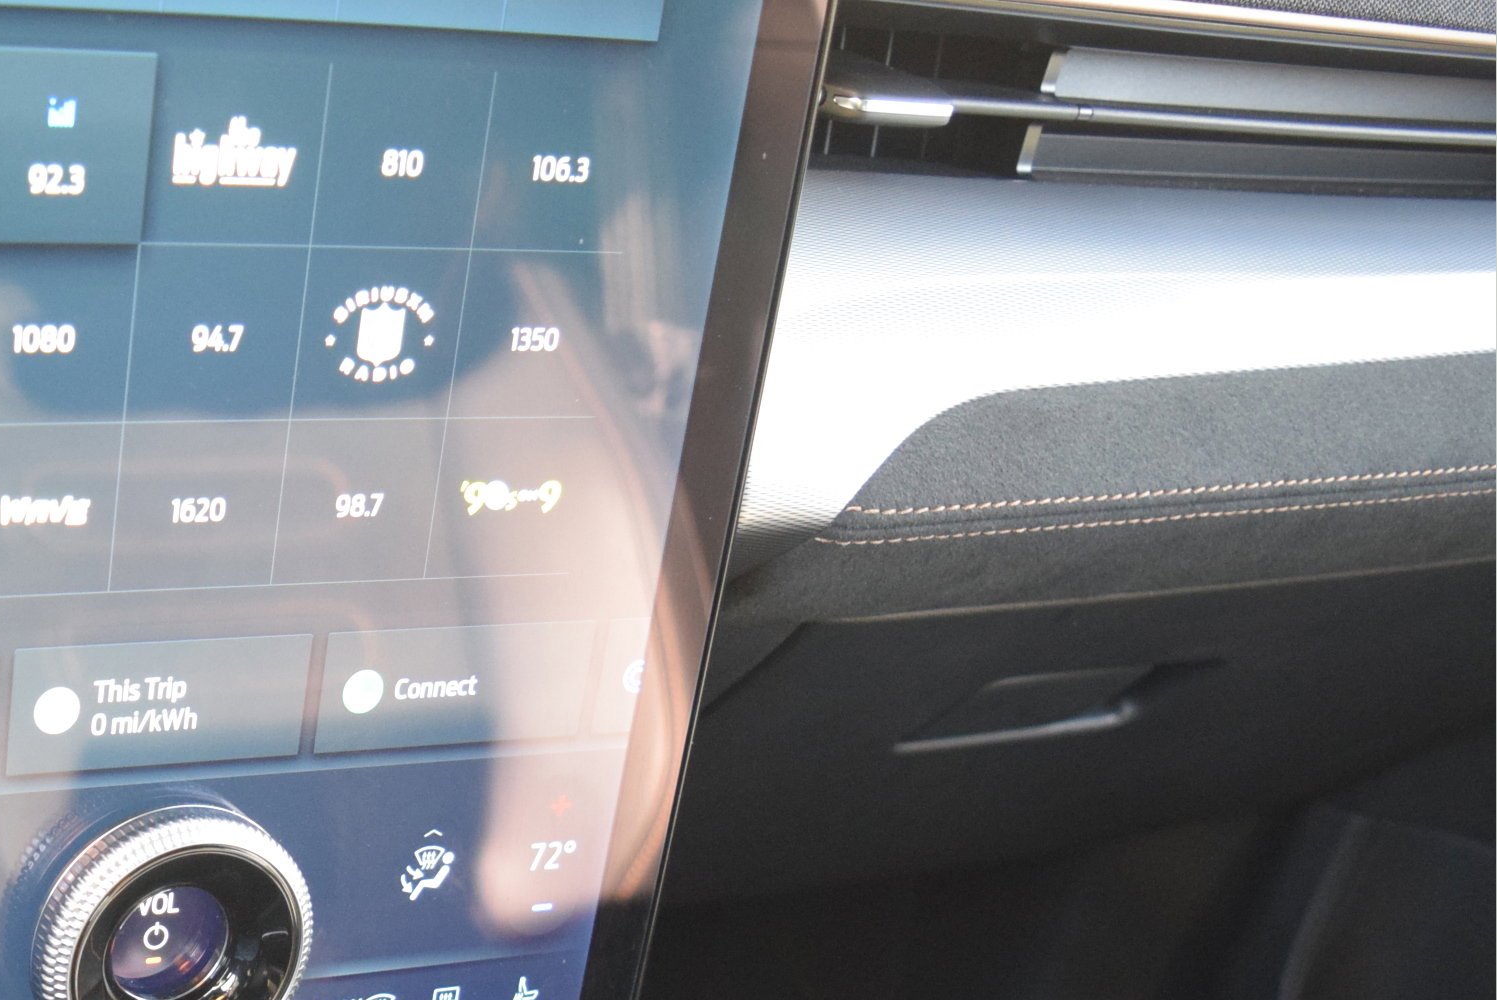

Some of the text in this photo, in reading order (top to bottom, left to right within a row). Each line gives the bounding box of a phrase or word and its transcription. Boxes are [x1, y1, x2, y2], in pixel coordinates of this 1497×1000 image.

[381, 149, 424, 178] 810
[532, 155, 590, 183] 106.3
[28, 163, 85, 195] 92.3
[12, 324, 76, 354] 1080
[191, 324, 244, 353] 94.7
[511, 326, 560, 352] 1350
[339, 356, 416, 383] RADIO
[171, 496, 227, 524] 1620
[335, 492, 385, 519] 98.7
[93, 675, 188, 704] This Trip
[394, 675, 478, 701] Connect
[90, 706, 198, 737] 0 mi/kWh
[137, 888, 180, 917] VOL
